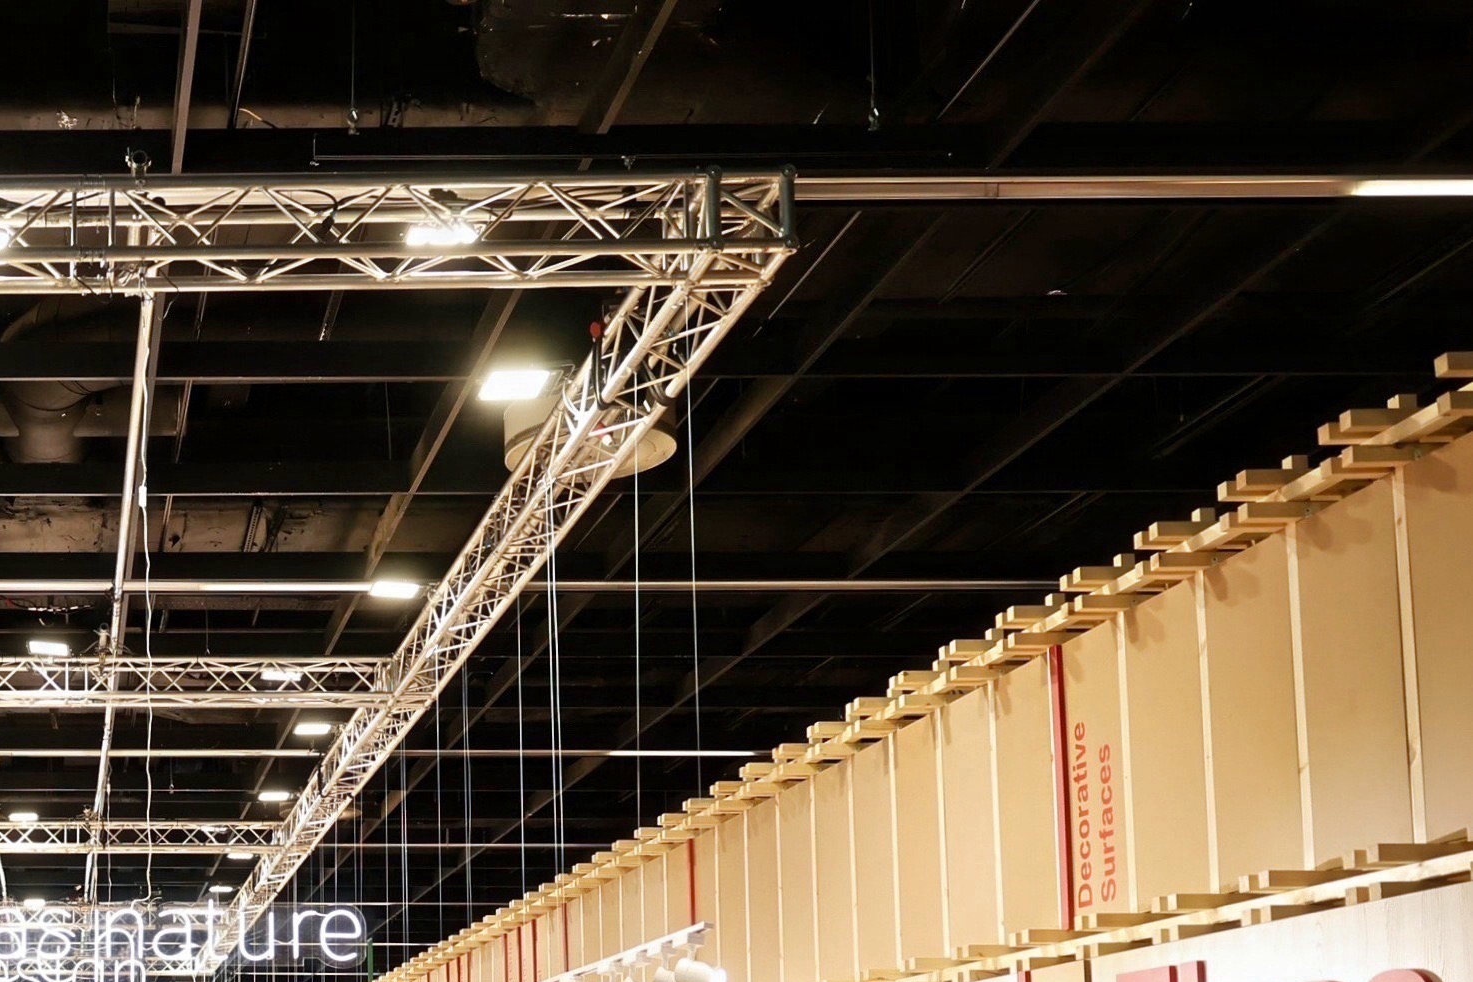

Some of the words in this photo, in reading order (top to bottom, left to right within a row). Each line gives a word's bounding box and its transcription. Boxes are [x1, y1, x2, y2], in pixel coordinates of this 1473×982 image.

[1072, 721, 1093, 909] Decorative
[1099, 743, 1116, 903] Surfaces
[105, 898, 362, 963] nature
